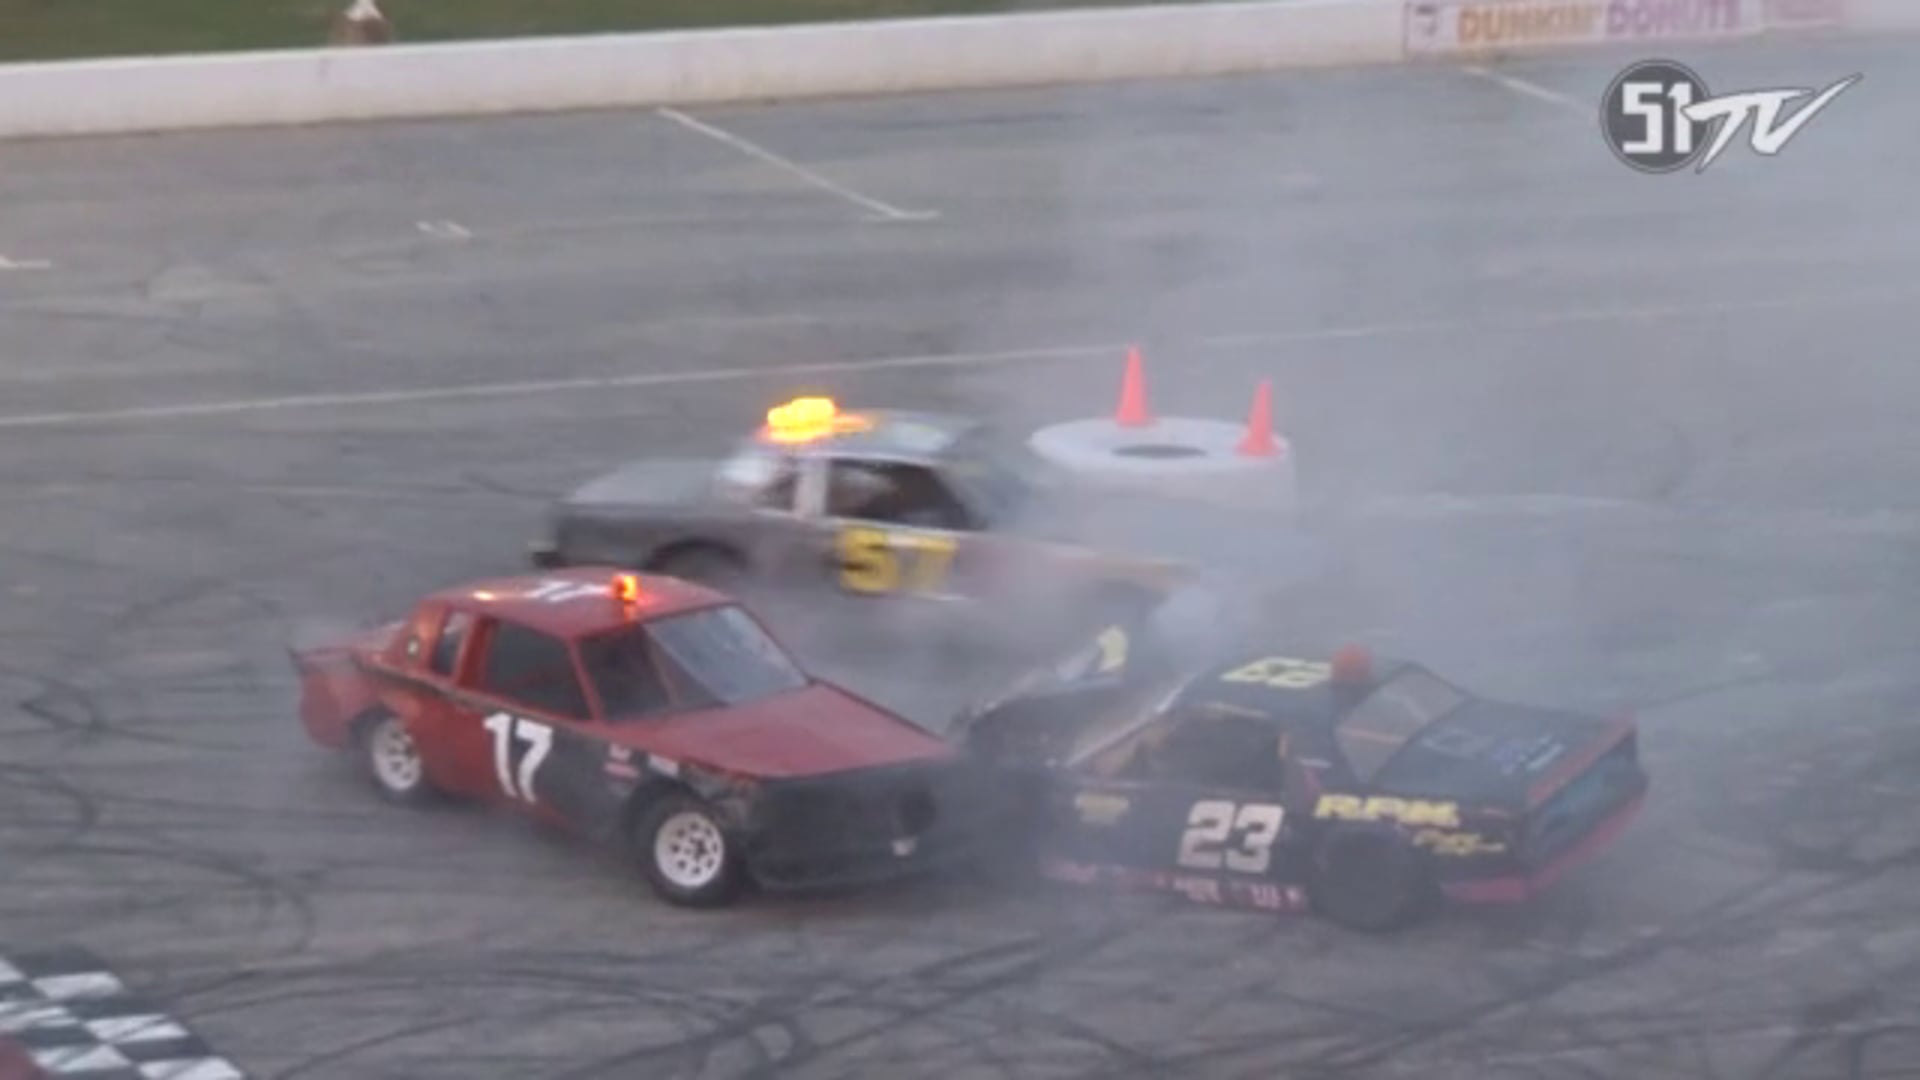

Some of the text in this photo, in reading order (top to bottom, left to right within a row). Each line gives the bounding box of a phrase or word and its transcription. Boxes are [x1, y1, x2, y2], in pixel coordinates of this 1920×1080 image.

[836, 527, 957, 596] 57
[484, 713, 553, 804] 17
[1178, 799, 1284, 874] 23
